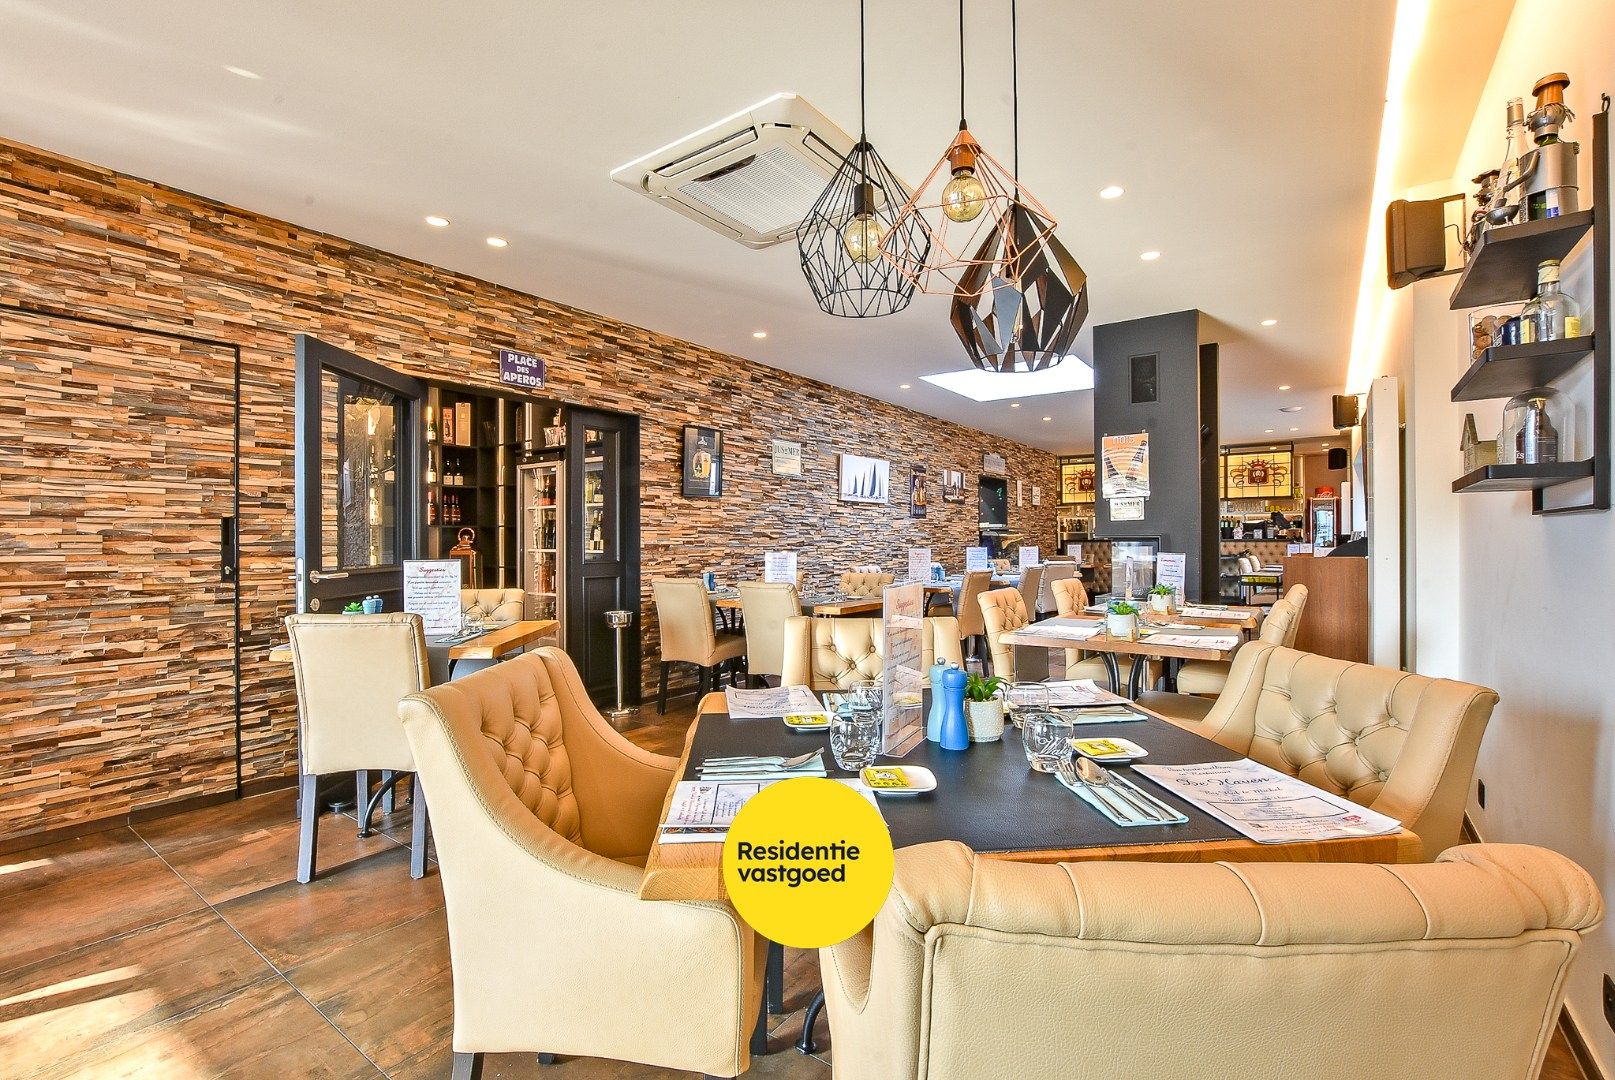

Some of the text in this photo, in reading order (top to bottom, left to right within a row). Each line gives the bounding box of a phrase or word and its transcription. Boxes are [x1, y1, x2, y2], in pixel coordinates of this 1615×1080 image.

[507, 353, 537, 368] PLACE
[516, 365, 530, 374] DES
[503, 371, 542, 387] APEROS
[1207, 777, 1270, 787] Haven
